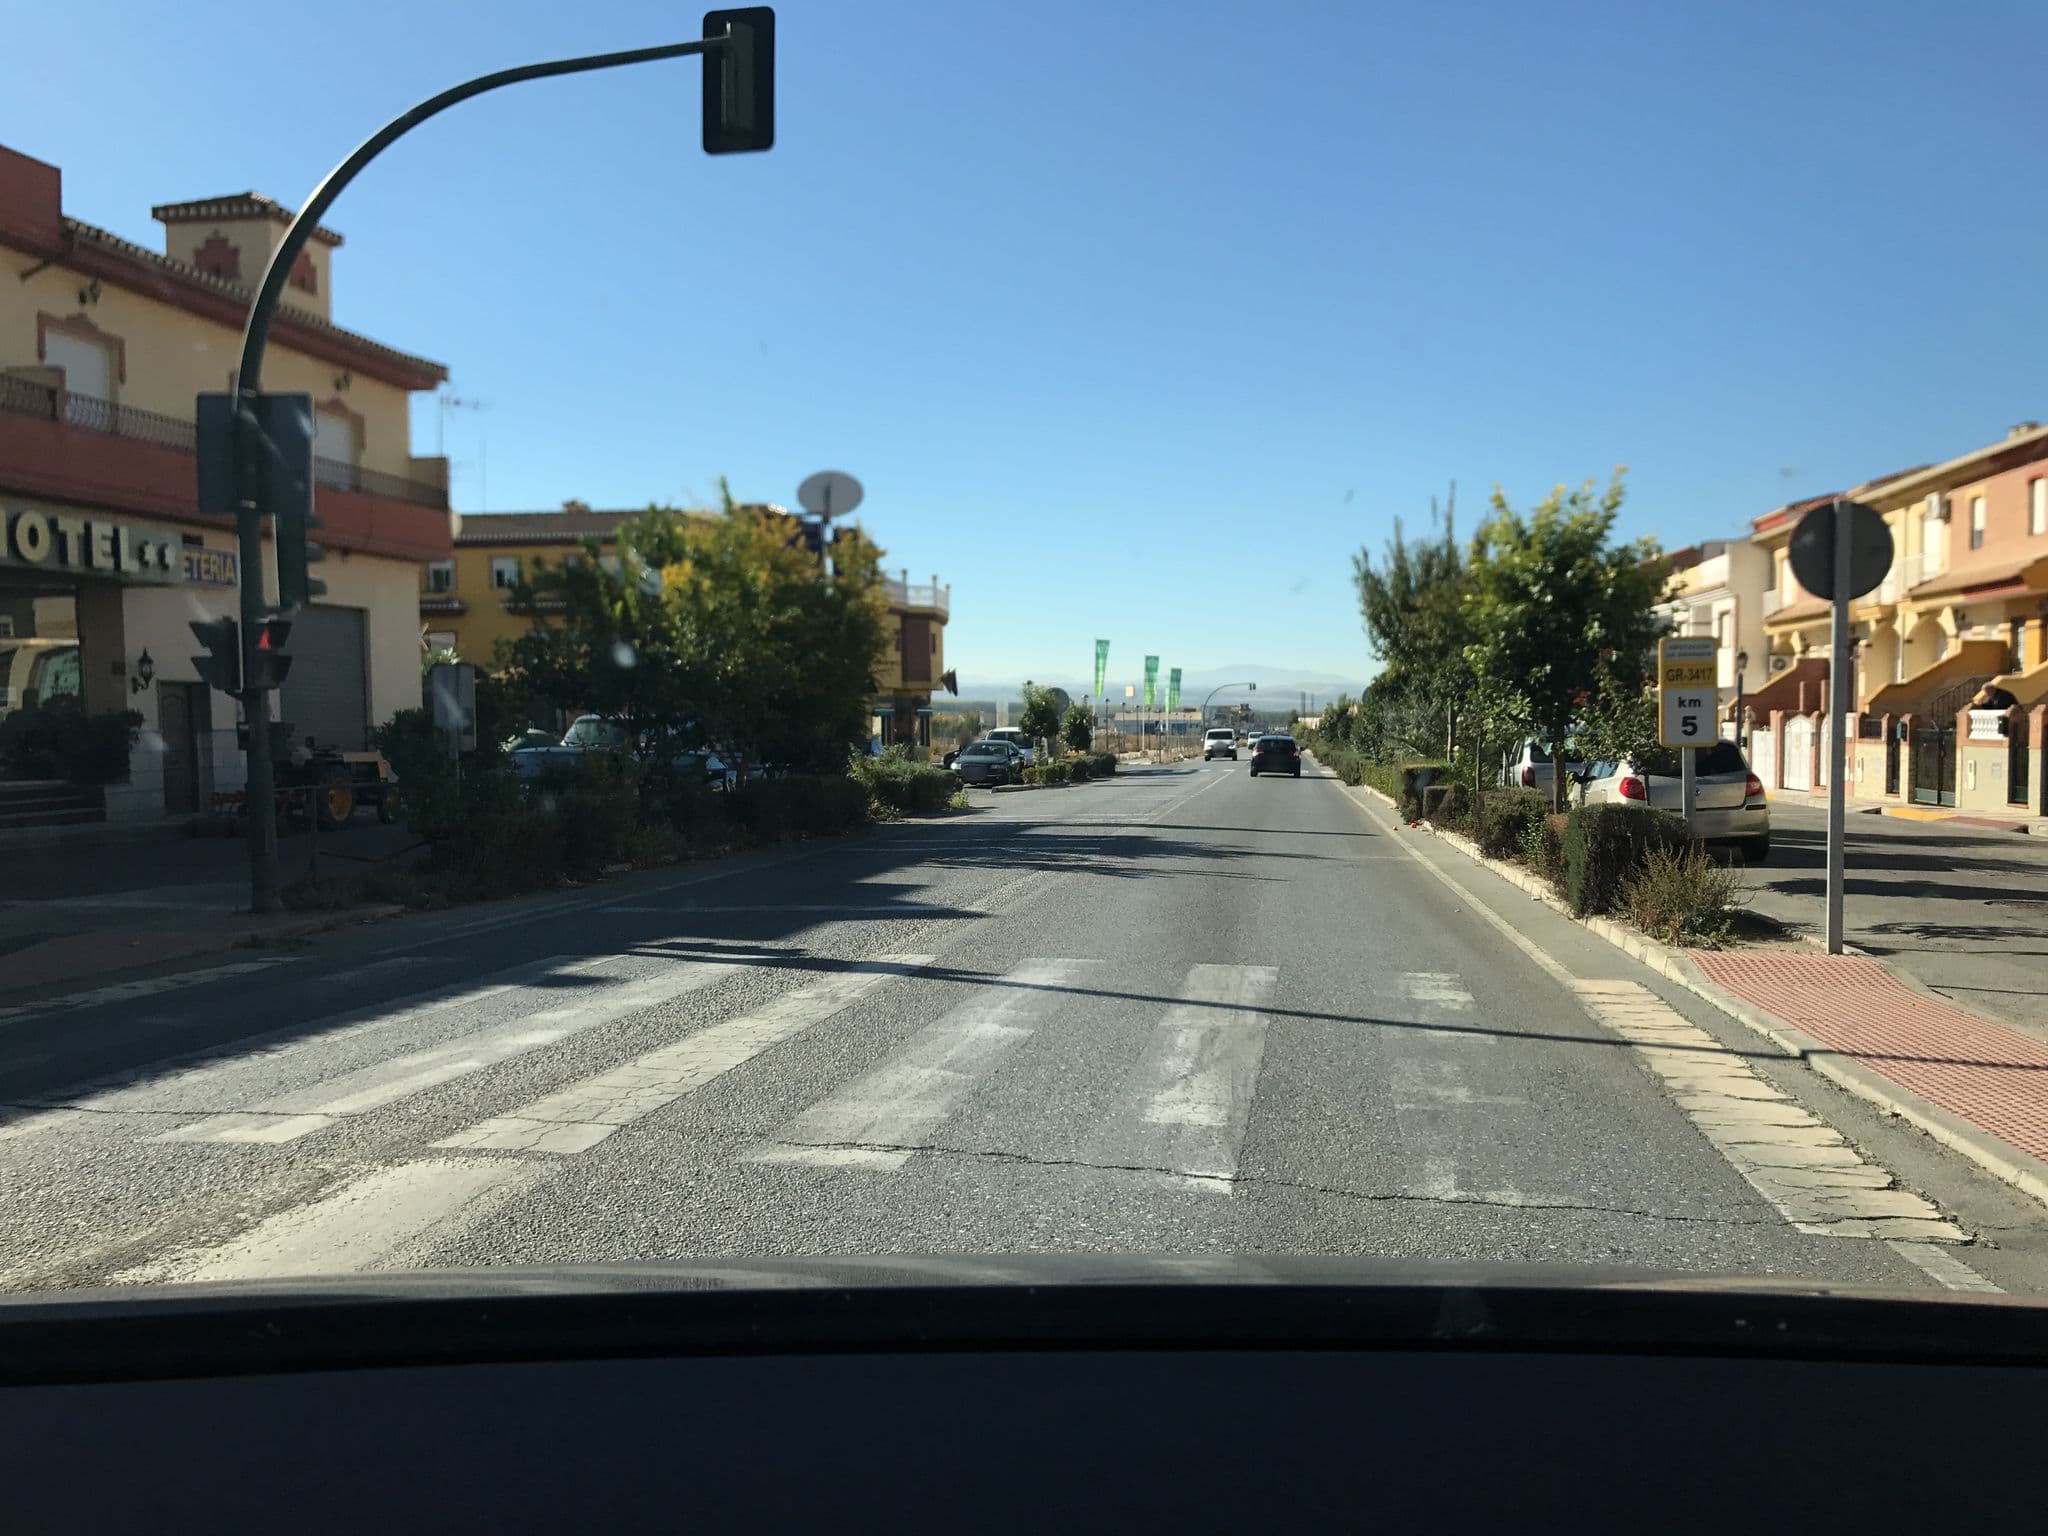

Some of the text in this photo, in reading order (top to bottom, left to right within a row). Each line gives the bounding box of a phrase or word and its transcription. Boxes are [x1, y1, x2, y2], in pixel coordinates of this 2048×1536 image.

[1666, 668, 1713, 681] GR-3417
[1678, 696, 1701, 708] km
[1681, 715, 1698, 736] 5
